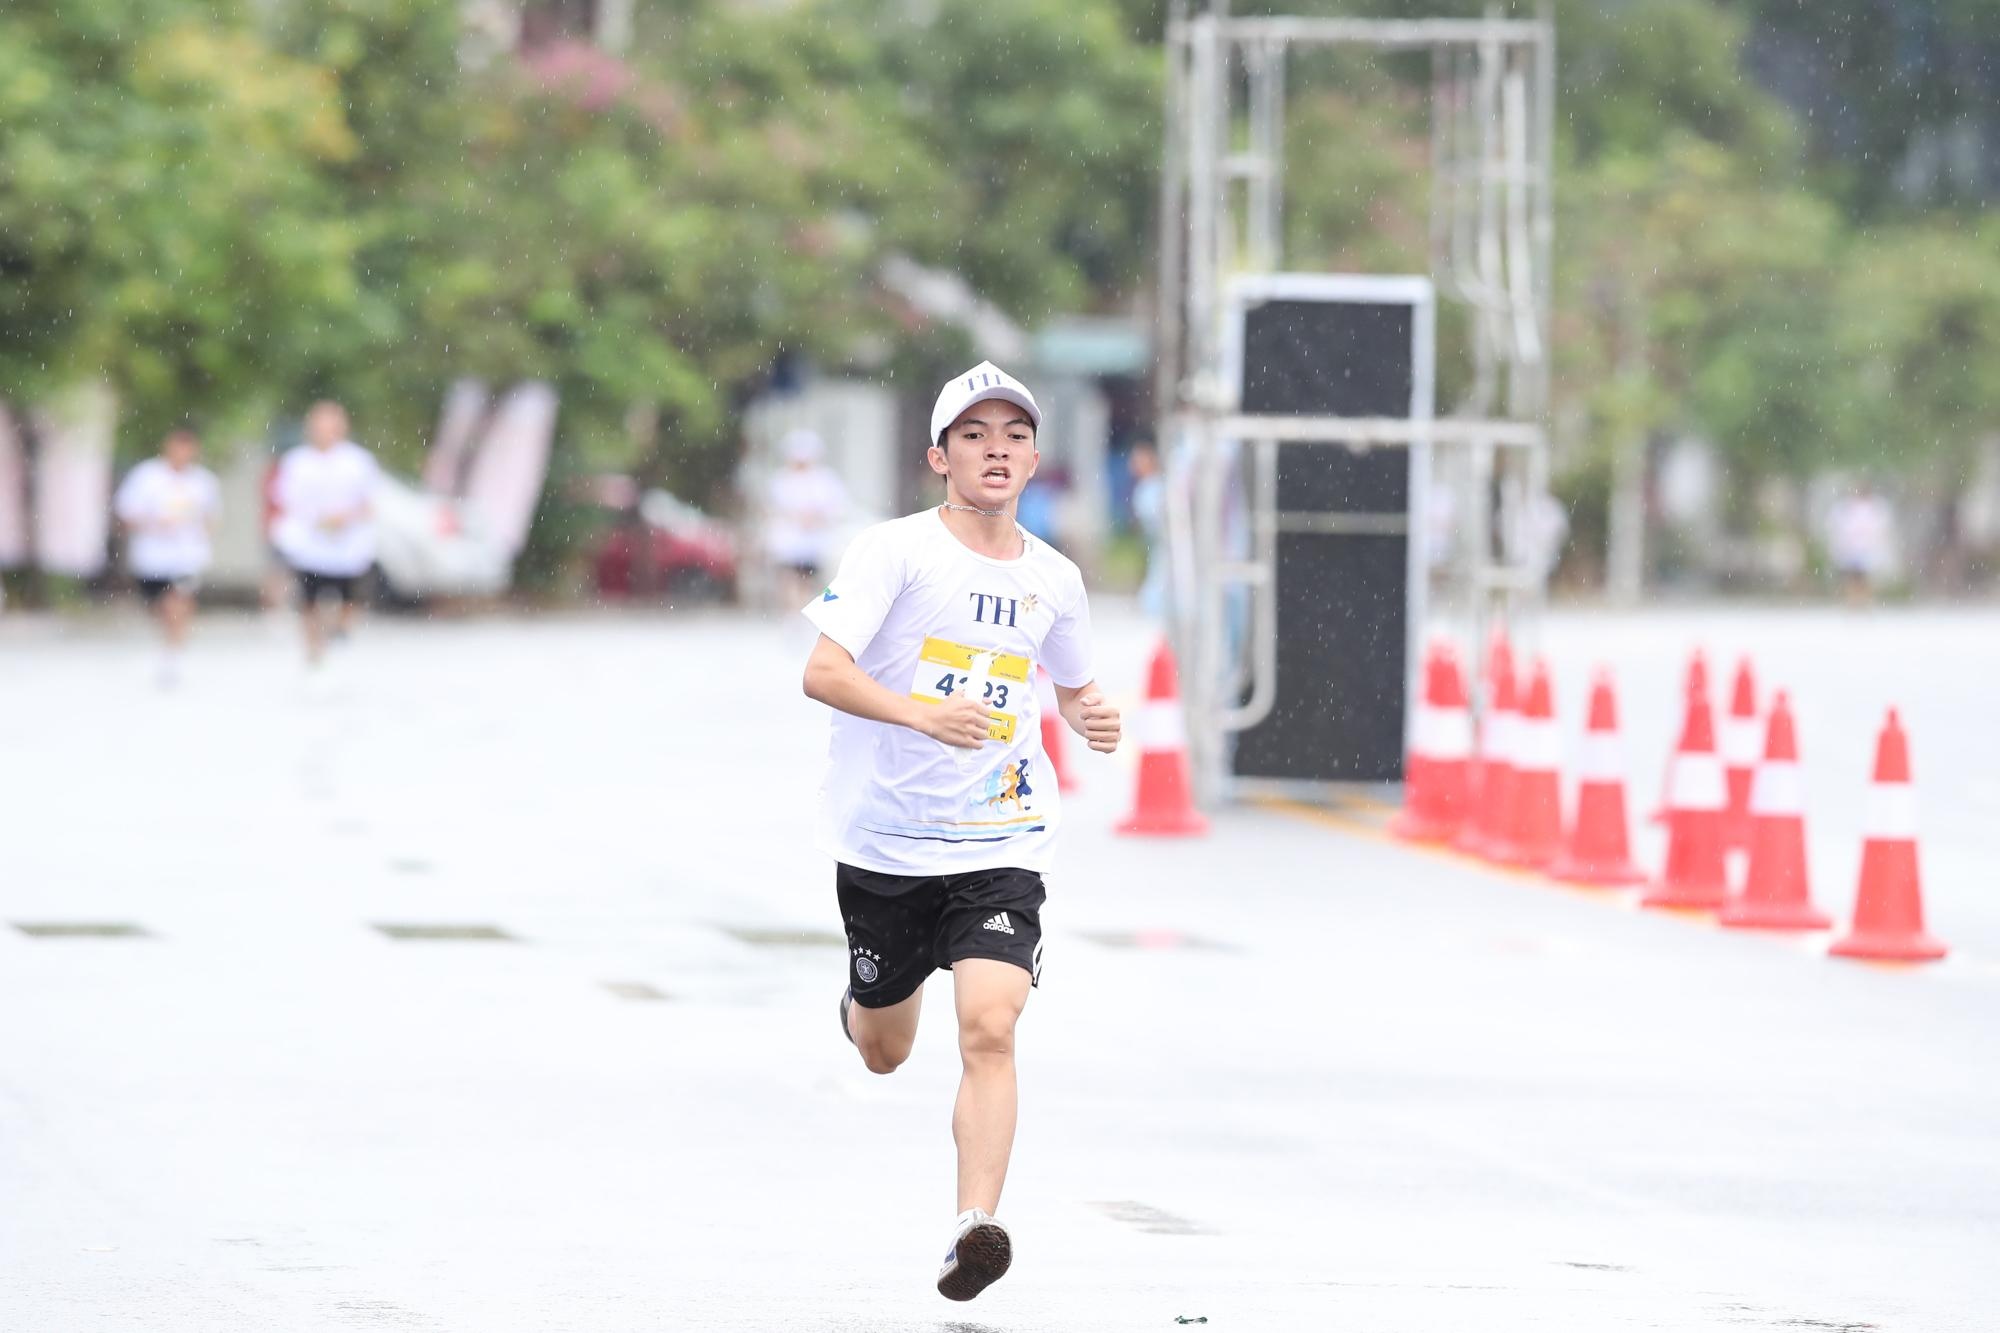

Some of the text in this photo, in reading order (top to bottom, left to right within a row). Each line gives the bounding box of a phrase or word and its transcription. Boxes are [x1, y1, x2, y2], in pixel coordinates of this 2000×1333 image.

[969, 592, 1019, 628] TH
[935, 673, 1009, 709] 43
[983, 922, 1015, 935] adidas
